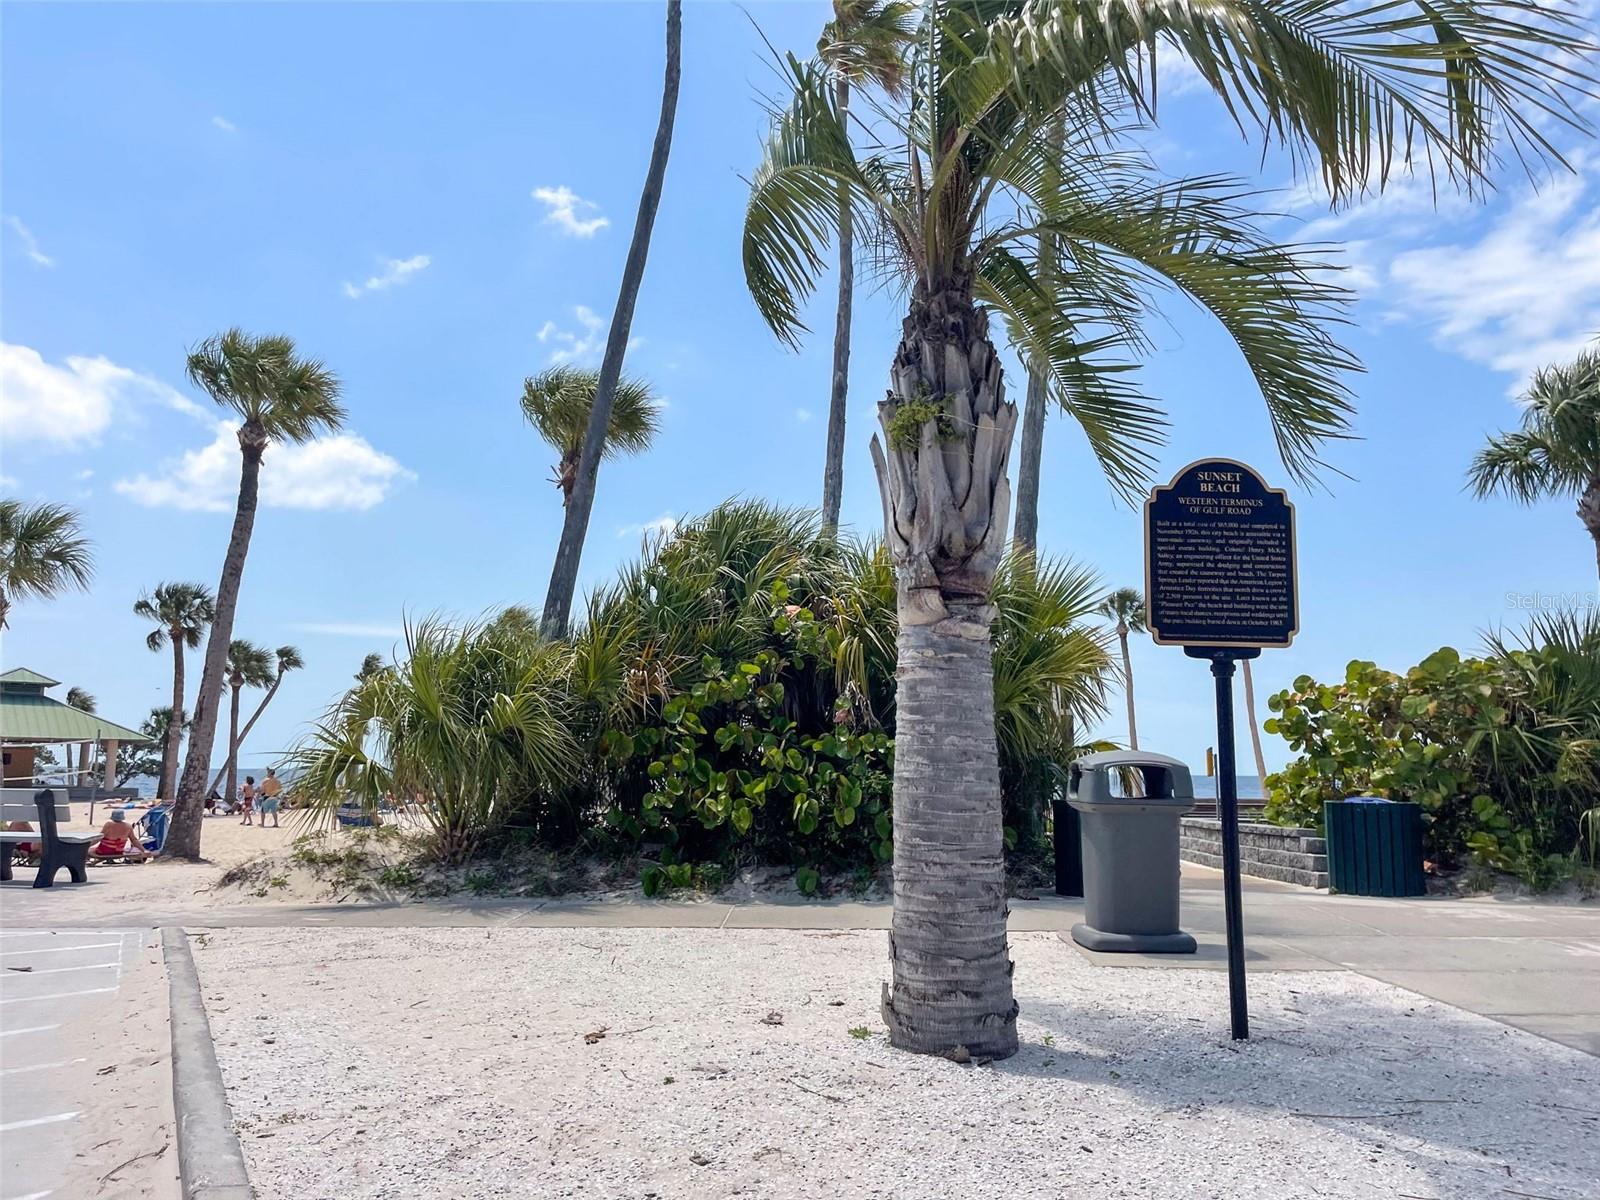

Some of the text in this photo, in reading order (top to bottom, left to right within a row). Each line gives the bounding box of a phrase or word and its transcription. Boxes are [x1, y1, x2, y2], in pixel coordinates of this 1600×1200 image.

[1197, 471, 1242, 482] SUNSET
[1200, 482, 1240, 493] BEACH
[1178, 497, 1263, 507] WESTERN TERMINUS
[1202, 506, 1226, 514] GULF
[1227, 507, 1252, 515] ROAD
